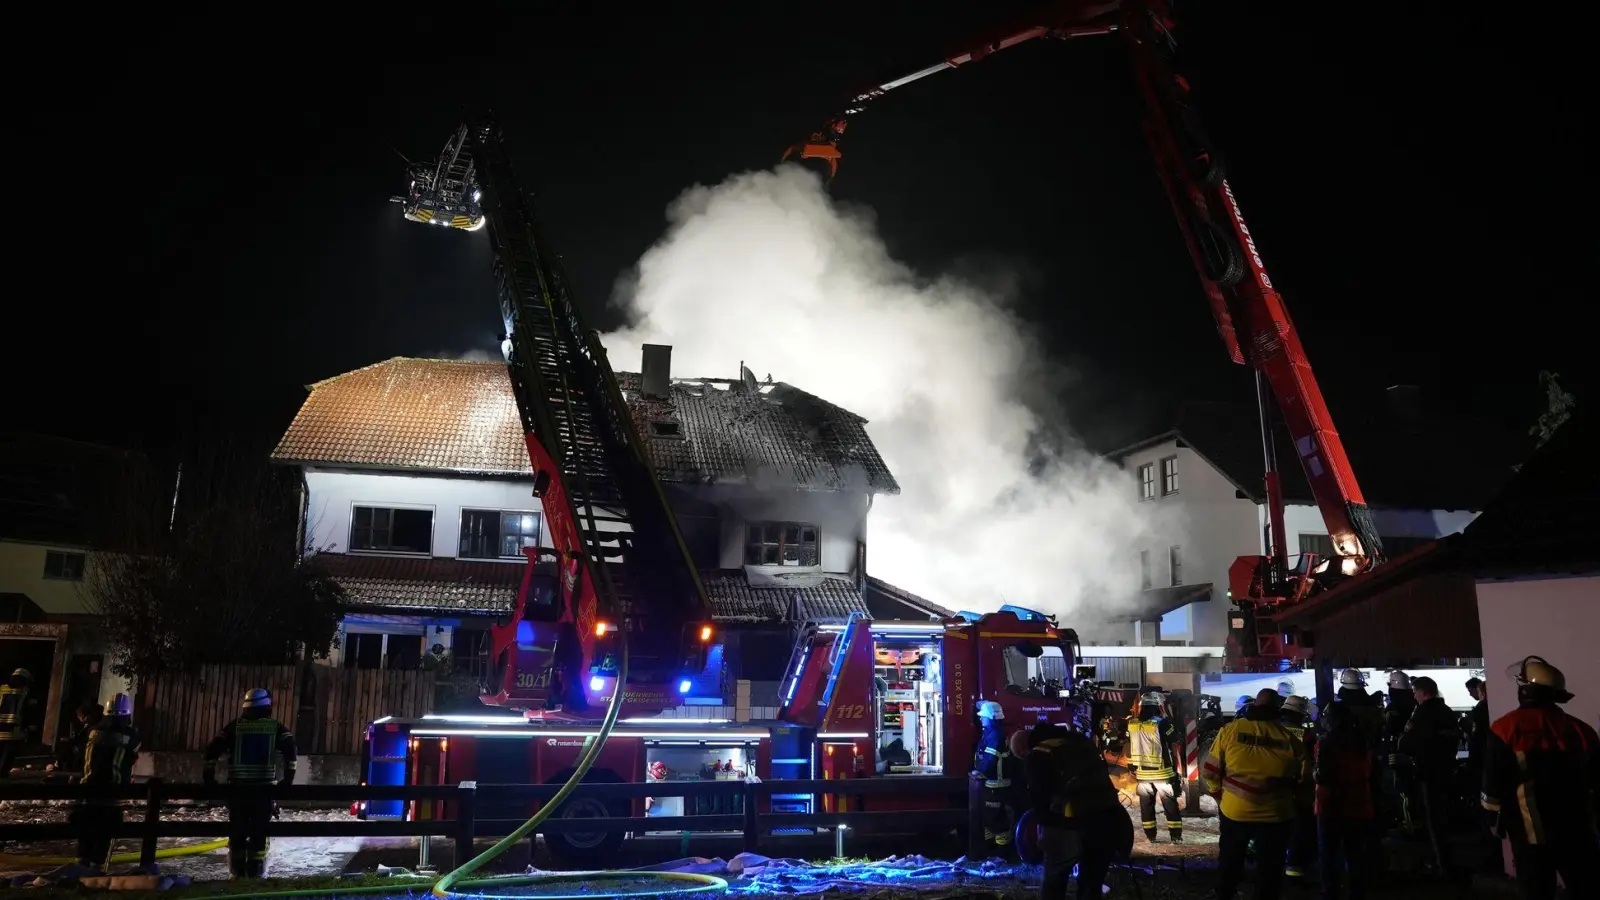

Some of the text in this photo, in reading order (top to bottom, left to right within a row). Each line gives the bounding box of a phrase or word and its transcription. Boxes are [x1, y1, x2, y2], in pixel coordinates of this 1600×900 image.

[516, 673, 546, 689] 30/1
[955, 679, 962, 691] XS
[837, 704, 865, 719] 112
